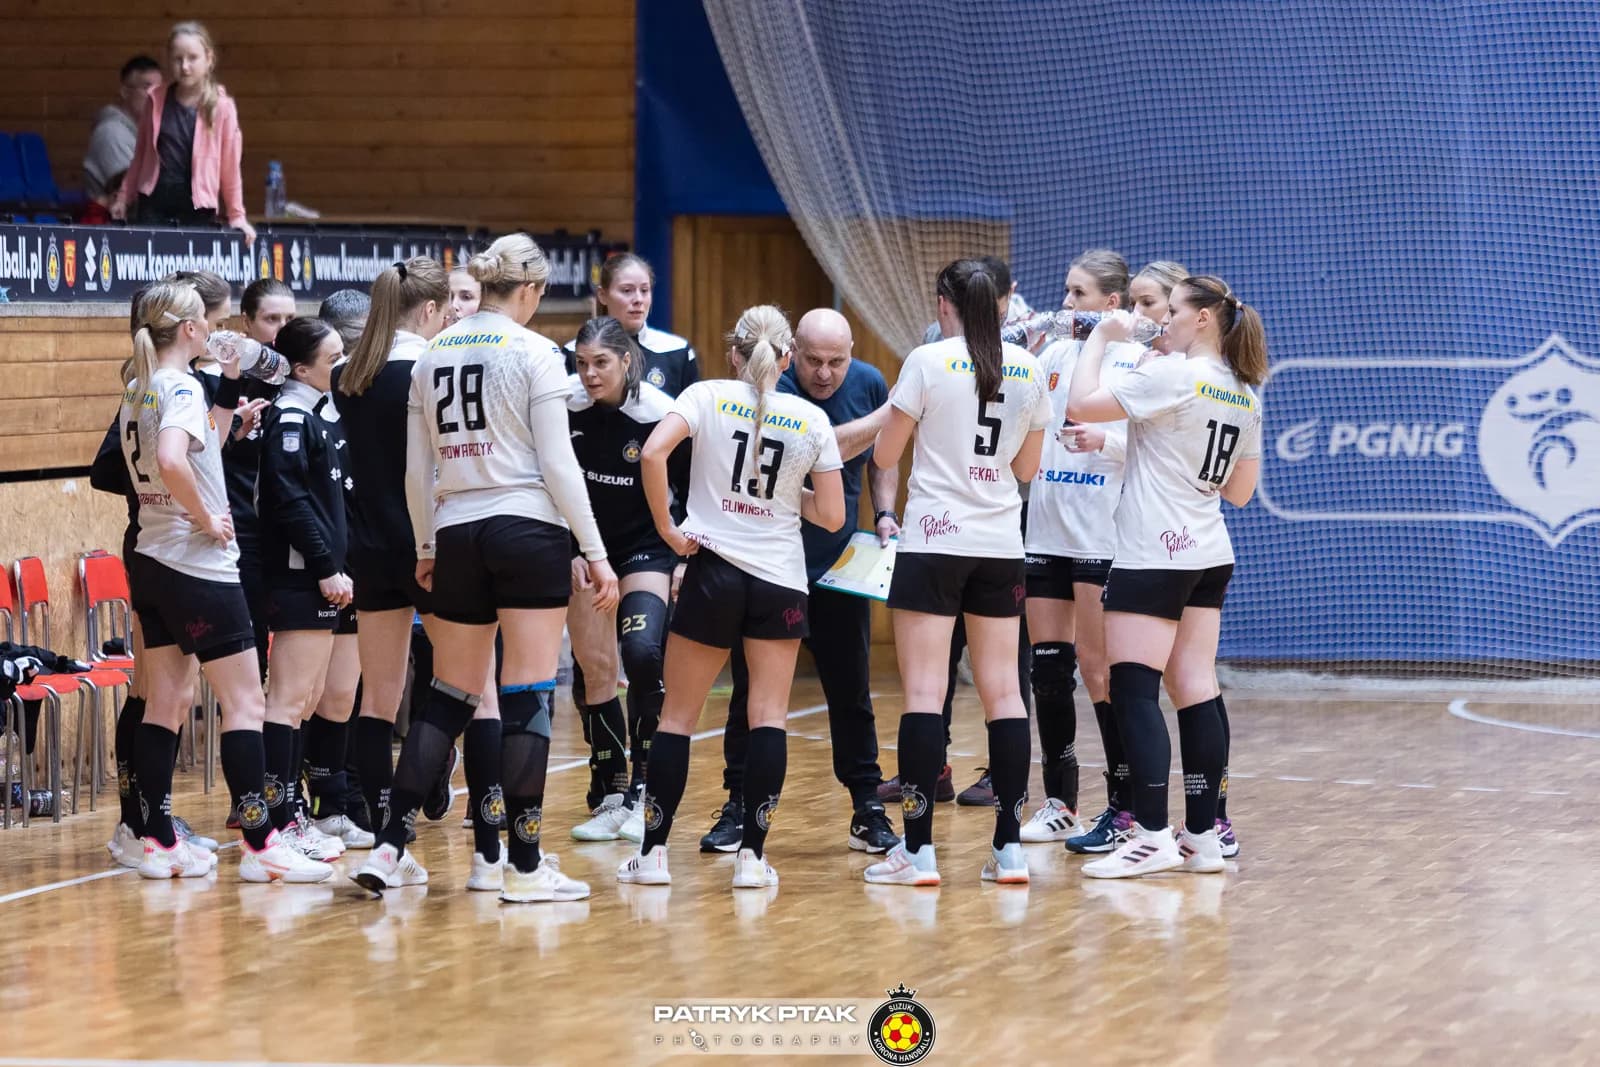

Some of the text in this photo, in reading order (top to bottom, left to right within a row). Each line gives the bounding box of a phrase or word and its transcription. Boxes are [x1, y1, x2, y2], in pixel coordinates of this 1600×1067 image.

[442, 334, 503, 346] LEWIATAN
[433, 364, 486, 435] 28
[1212, 387, 1250, 408] LEWIATAN
[974, 393, 1005, 456] 5
[1328, 423, 1464, 457] PGNiG
[126, 420, 151, 483] 2
[731, 430, 784, 500] 13
[1197, 419, 1240, 485] 18
[587, 471, 634, 486] SUZUKI
[1045, 470, 1105, 486] SUZUKI
[622, 614, 647, 636] 23
